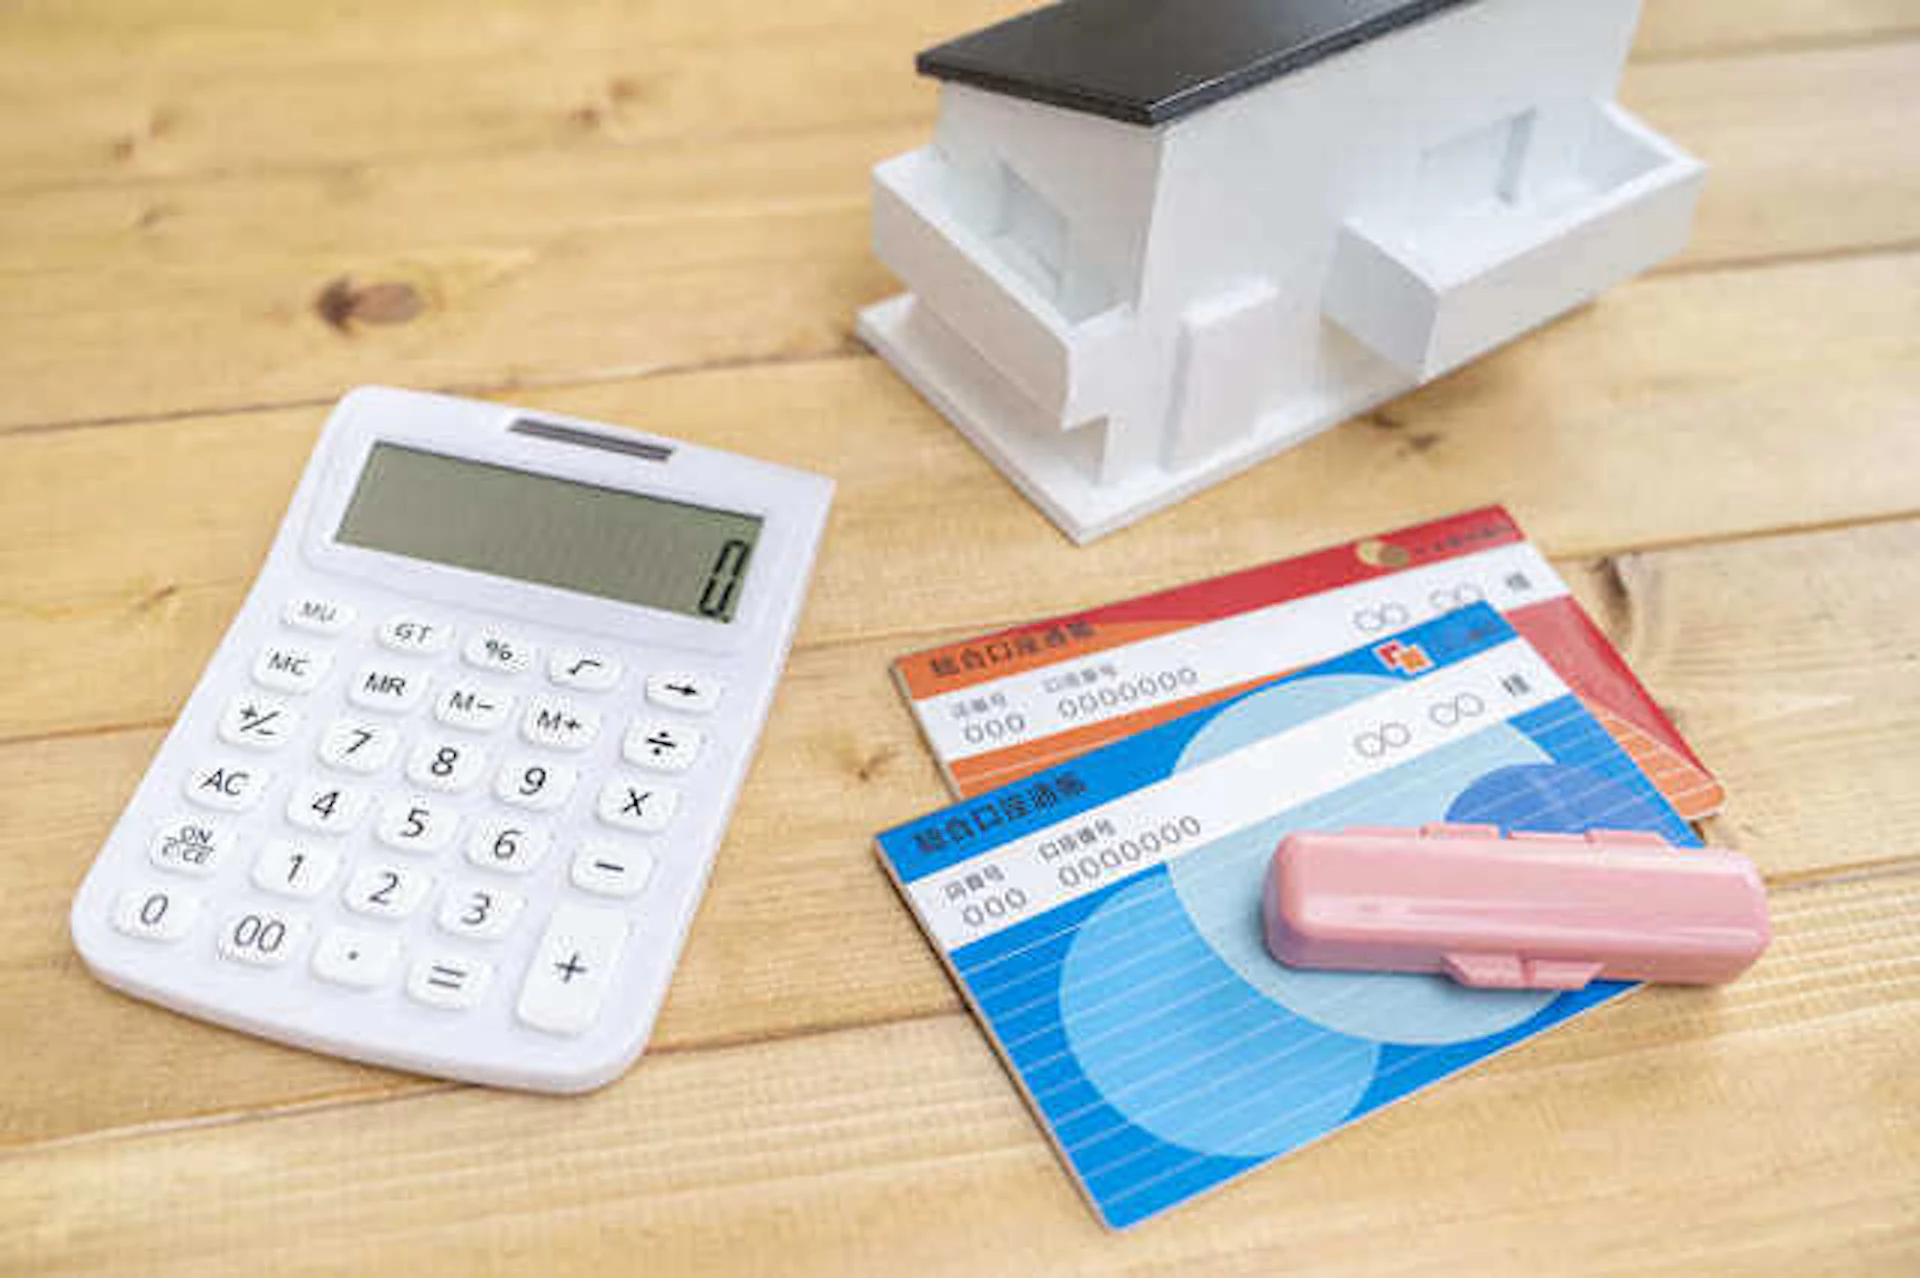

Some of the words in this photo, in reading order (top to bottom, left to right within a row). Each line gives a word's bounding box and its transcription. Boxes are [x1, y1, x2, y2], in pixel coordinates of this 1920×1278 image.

[394, 622, 434, 643] GT
[267, 649, 309, 676] MC
[363, 672, 406, 698] MR
[536, 709, 582, 736] M+
[345, 728, 374, 755] 7
[430, 746, 459, 778] 8
[198, 767, 249, 798] AC
[518, 766, 547, 797] 9
[311, 790, 340, 820] 4
[399, 807, 429, 839] 5
[492, 828, 522, 861] 6
[287, 853, 305, 883] 1
[368, 871, 399, 906] 2
[140, 893, 169, 928] 0
[460, 892, 492, 926] 3
[232, 913, 286, 953] 00
